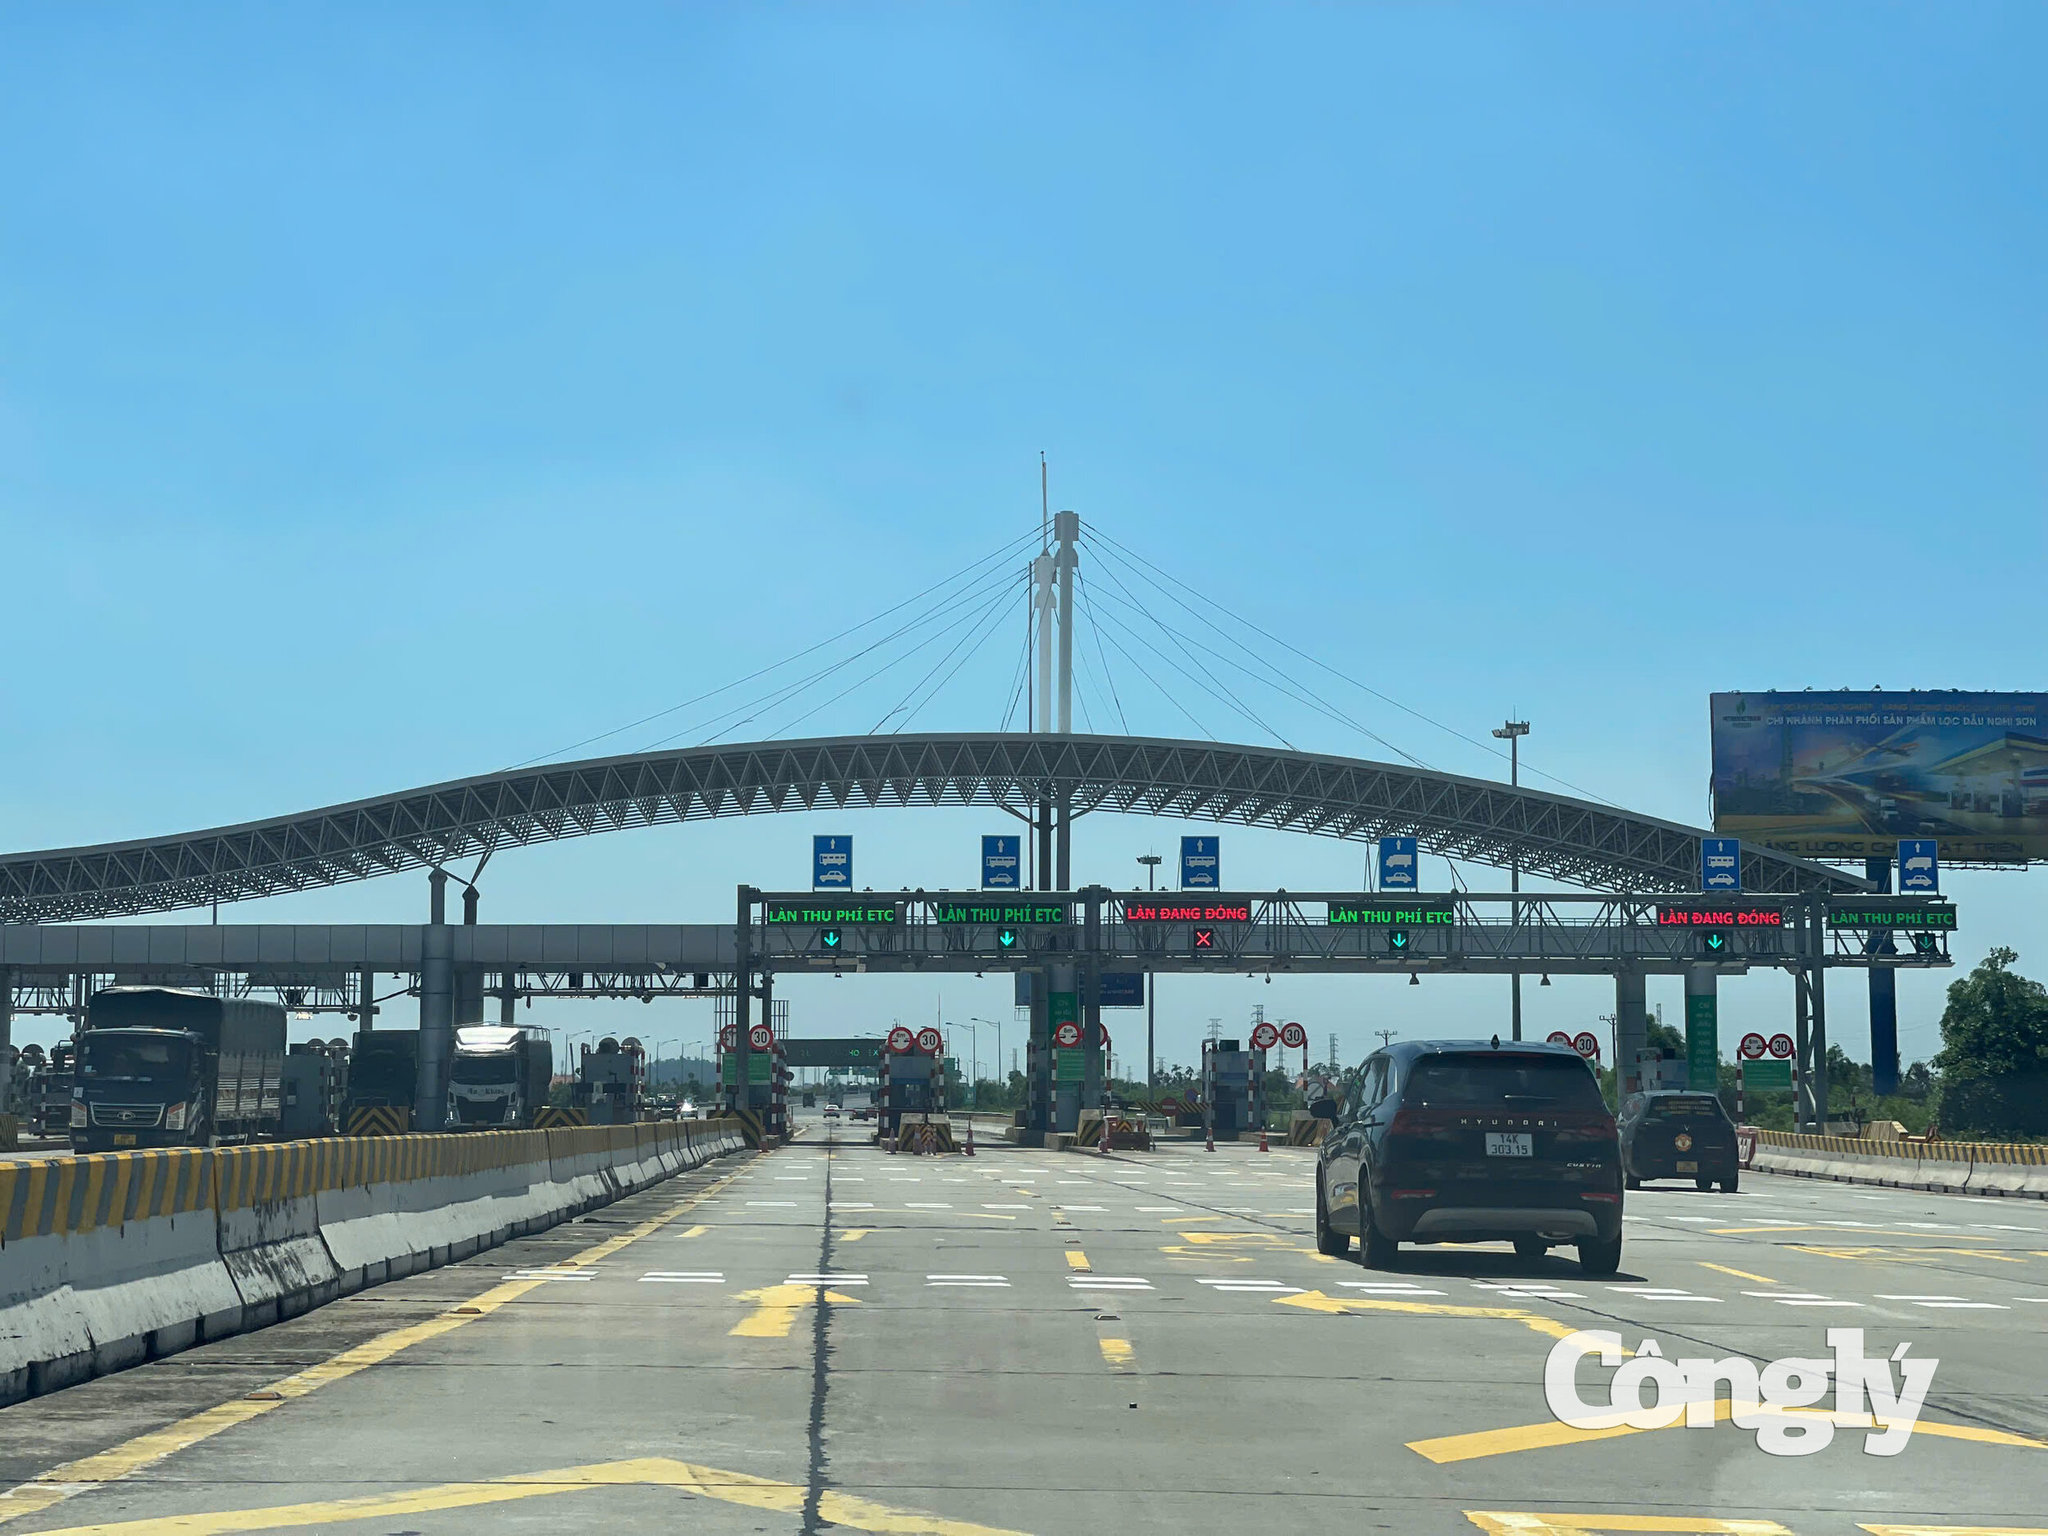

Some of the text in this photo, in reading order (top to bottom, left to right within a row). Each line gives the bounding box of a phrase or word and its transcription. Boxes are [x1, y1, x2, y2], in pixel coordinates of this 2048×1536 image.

[769, 906, 894, 922] LÀN THU PHÍ ETC
[938, 904, 1062, 923] LÀN THU PHÍ ETC
[1127, 904, 1248, 921] LÀN ĐANG ĐÓNG
[1330, 907, 1453, 924] LÀN THU PHÍ ETC
[1659, 908, 1780, 925] LÀN ĐANG ĐÓNG
[1831, 909, 1954, 925] LÀN THU PHÍ ETC
[754, 1031, 767, 1043] 30
[922, 1034, 936, 1046] 30
[1286, 1029, 1300, 1041] 30
[1579, 1038, 1592, 1051] 30
[1774, 1040, 1788, 1052] 30
[1460, 1118, 1558, 1127] HYUNDAI
[1500, 1134, 1519, 1144] 14K
[1491, 1144, 1528, 1155] 303.15
